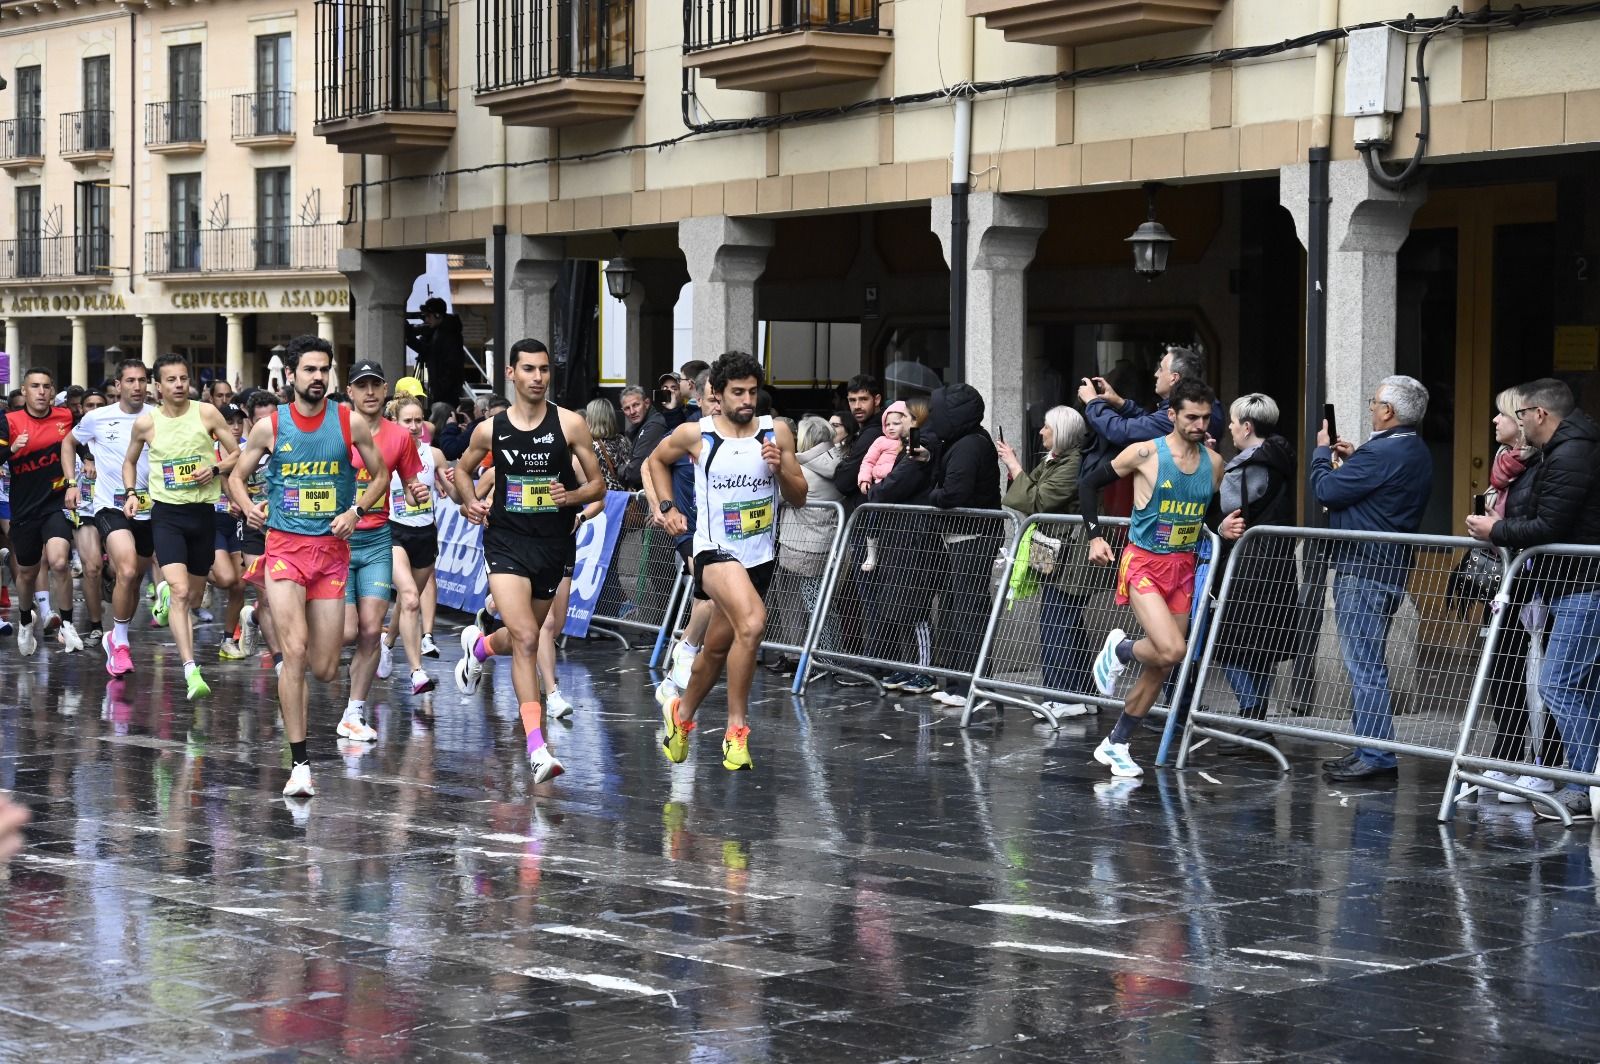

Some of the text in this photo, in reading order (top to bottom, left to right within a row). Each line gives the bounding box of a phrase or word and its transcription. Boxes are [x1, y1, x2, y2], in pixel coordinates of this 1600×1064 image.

[1576, 257, 1588, 281] 2
[83, 294, 126, 311] PLAZA
[171, 289, 349, 309] CERVECERIA ASADOR
[521, 452, 551, 461] VICKY
[178, 463, 197, 476] 208
[281, 461, 340, 477] BIKILA
[712, 474, 773, 493] intelligent
[305, 490, 330, 500] ROSADO
[530, 486, 550, 495] DANIEL
[314, 501, 320, 511] 5
[536, 496, 543, 506] 8
[749, 508, 766, 519] KEVIN
[1160, 500, 1205, 516] BIKILA
[754, 520, 761, 528] 3
[1181, 536, 1187, 544] 2
